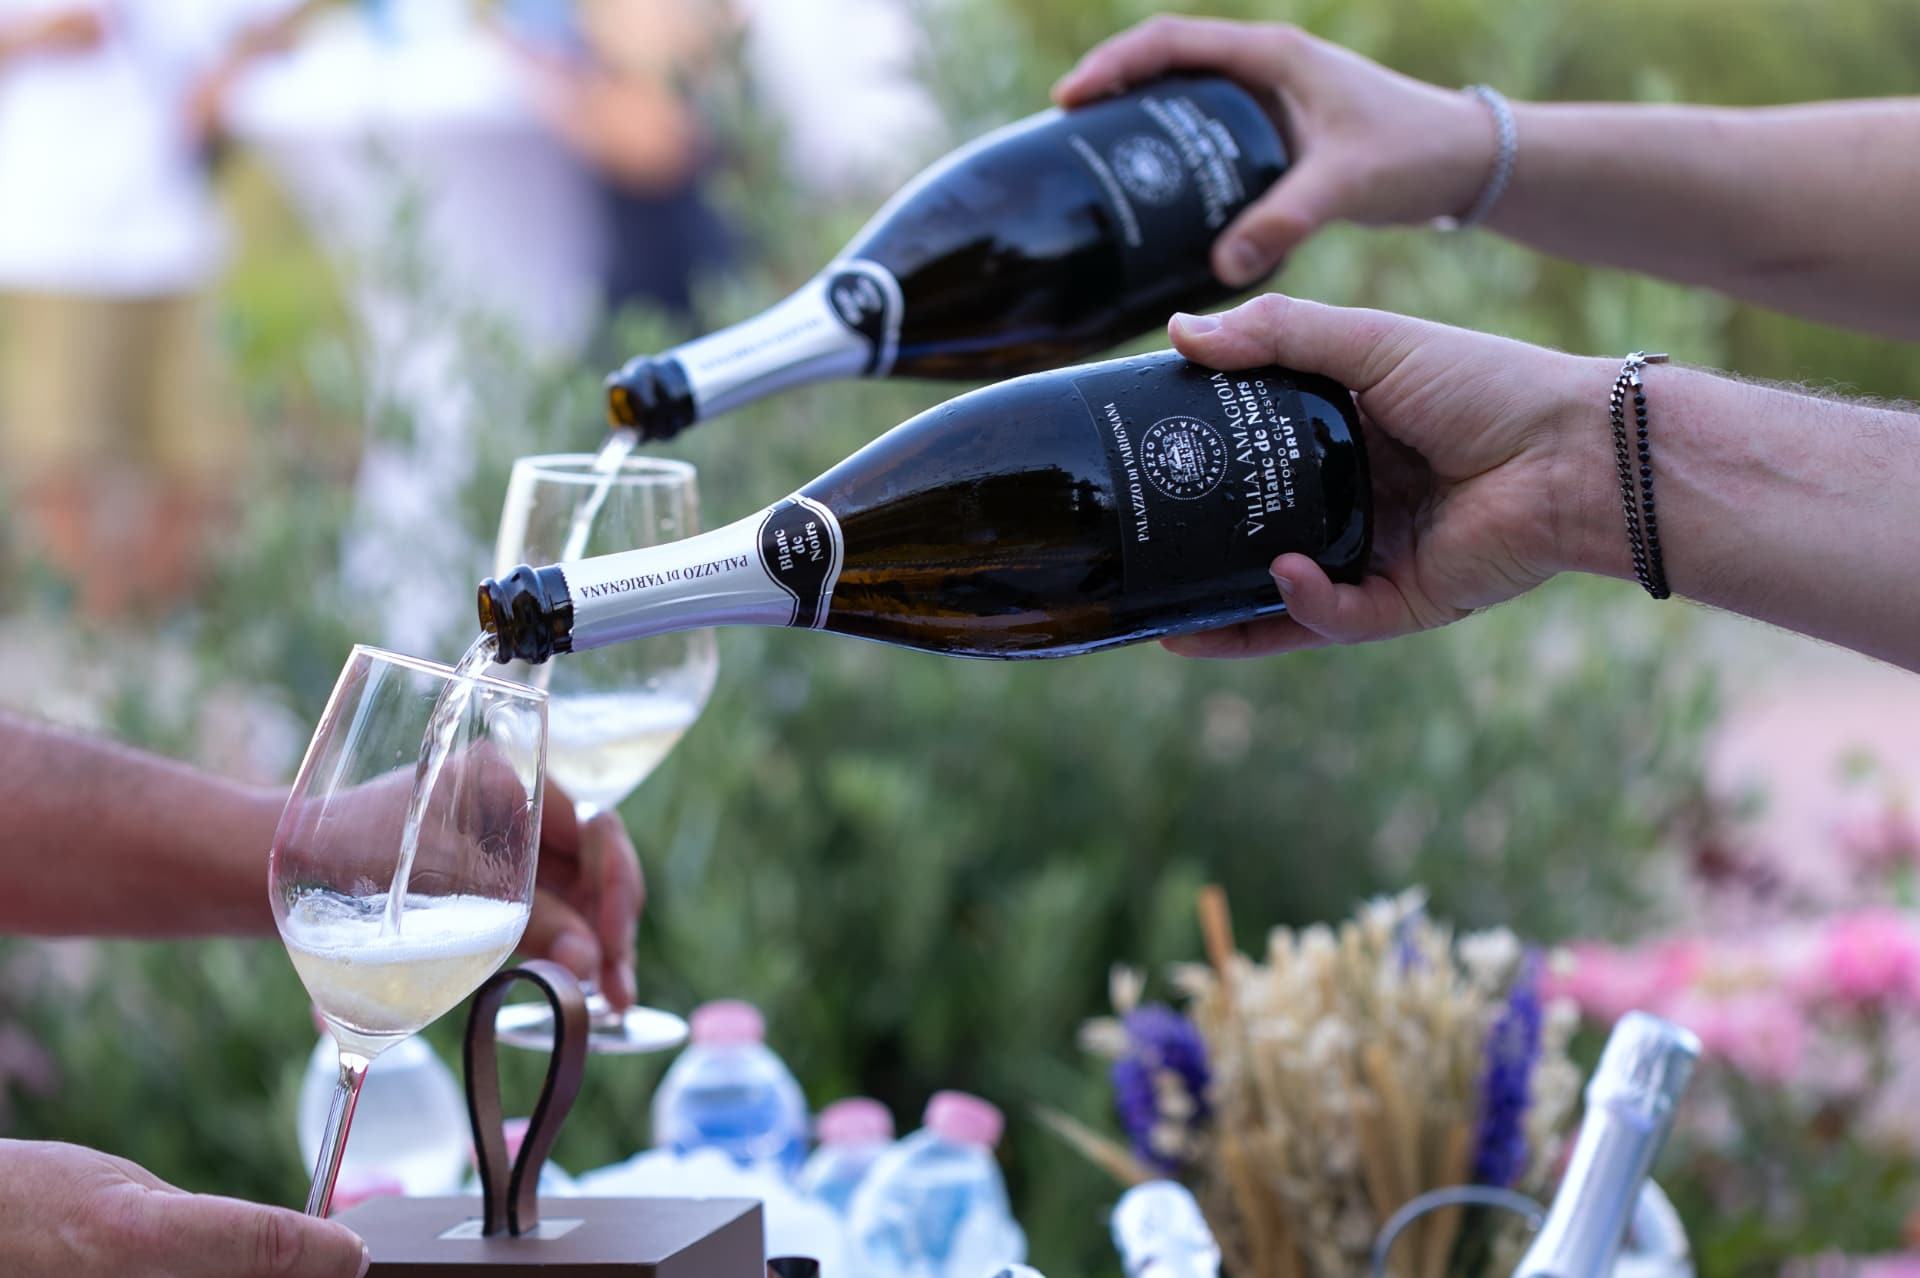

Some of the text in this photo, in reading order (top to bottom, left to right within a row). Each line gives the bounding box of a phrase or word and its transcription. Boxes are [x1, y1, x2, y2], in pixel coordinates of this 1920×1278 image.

[1153, 425, 1167, 437] DI
[1180, 421, 1221, 489] VARIGNANA
[1210, 372, 1265, 536] VILLA AMAGIOIA
[1236, 381, 1282, 513] Blanc de Noirs
[1254, 380, 1296, 508] METODO CLASSICO
[1279, 416, 1300, 460] BRUT
[1103, 402, 1150, 542] PALAZZO DI VARIGNANA
[1145, 442, 1182, 494] PALAZZO
[774, 529, 794, 571] Blanc
[792, 535, 806, 554] de
[805, 521, 824, 562] Noirs
[580, 555, 748, 599] PALAZZO DI VARIGNANA
